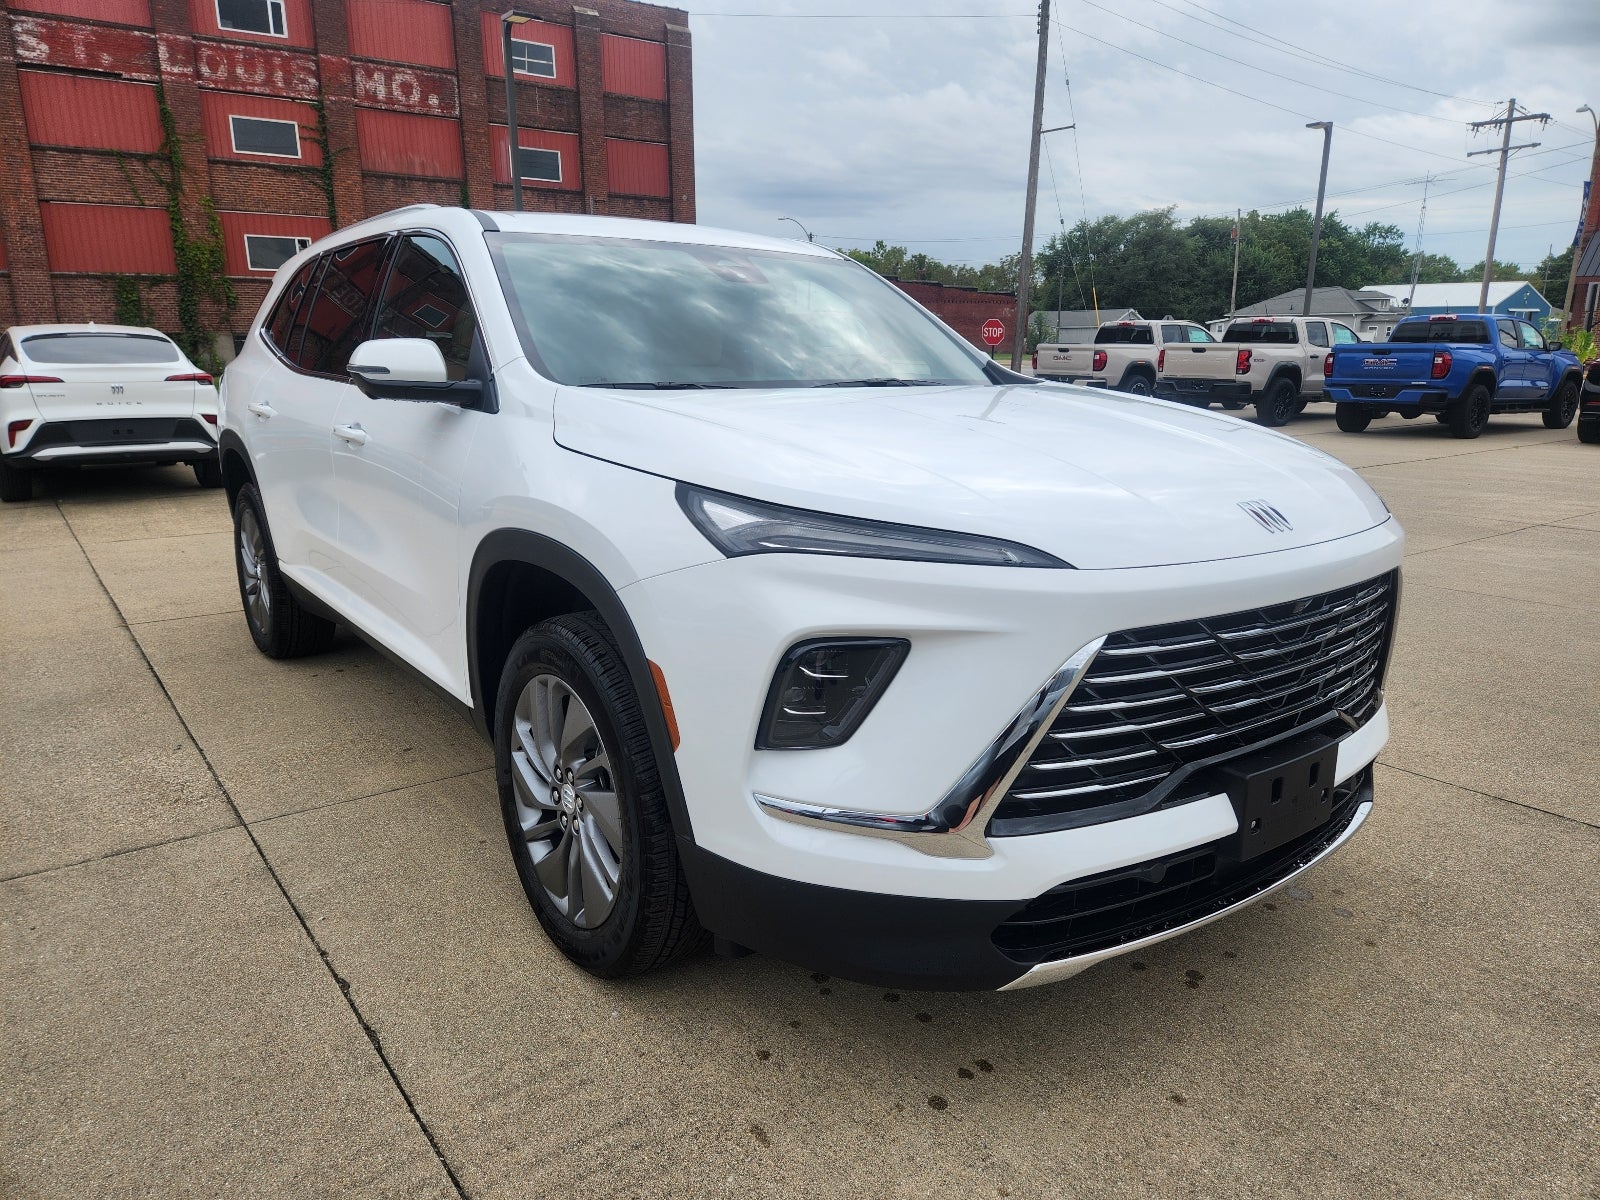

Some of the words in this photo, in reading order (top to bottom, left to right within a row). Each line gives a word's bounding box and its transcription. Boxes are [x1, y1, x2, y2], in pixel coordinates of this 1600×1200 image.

[158, 38, 319, 90] LOUIS
[983, 327, 1003, 338] STOP
[1363, 358, 1398, 366] GMC
